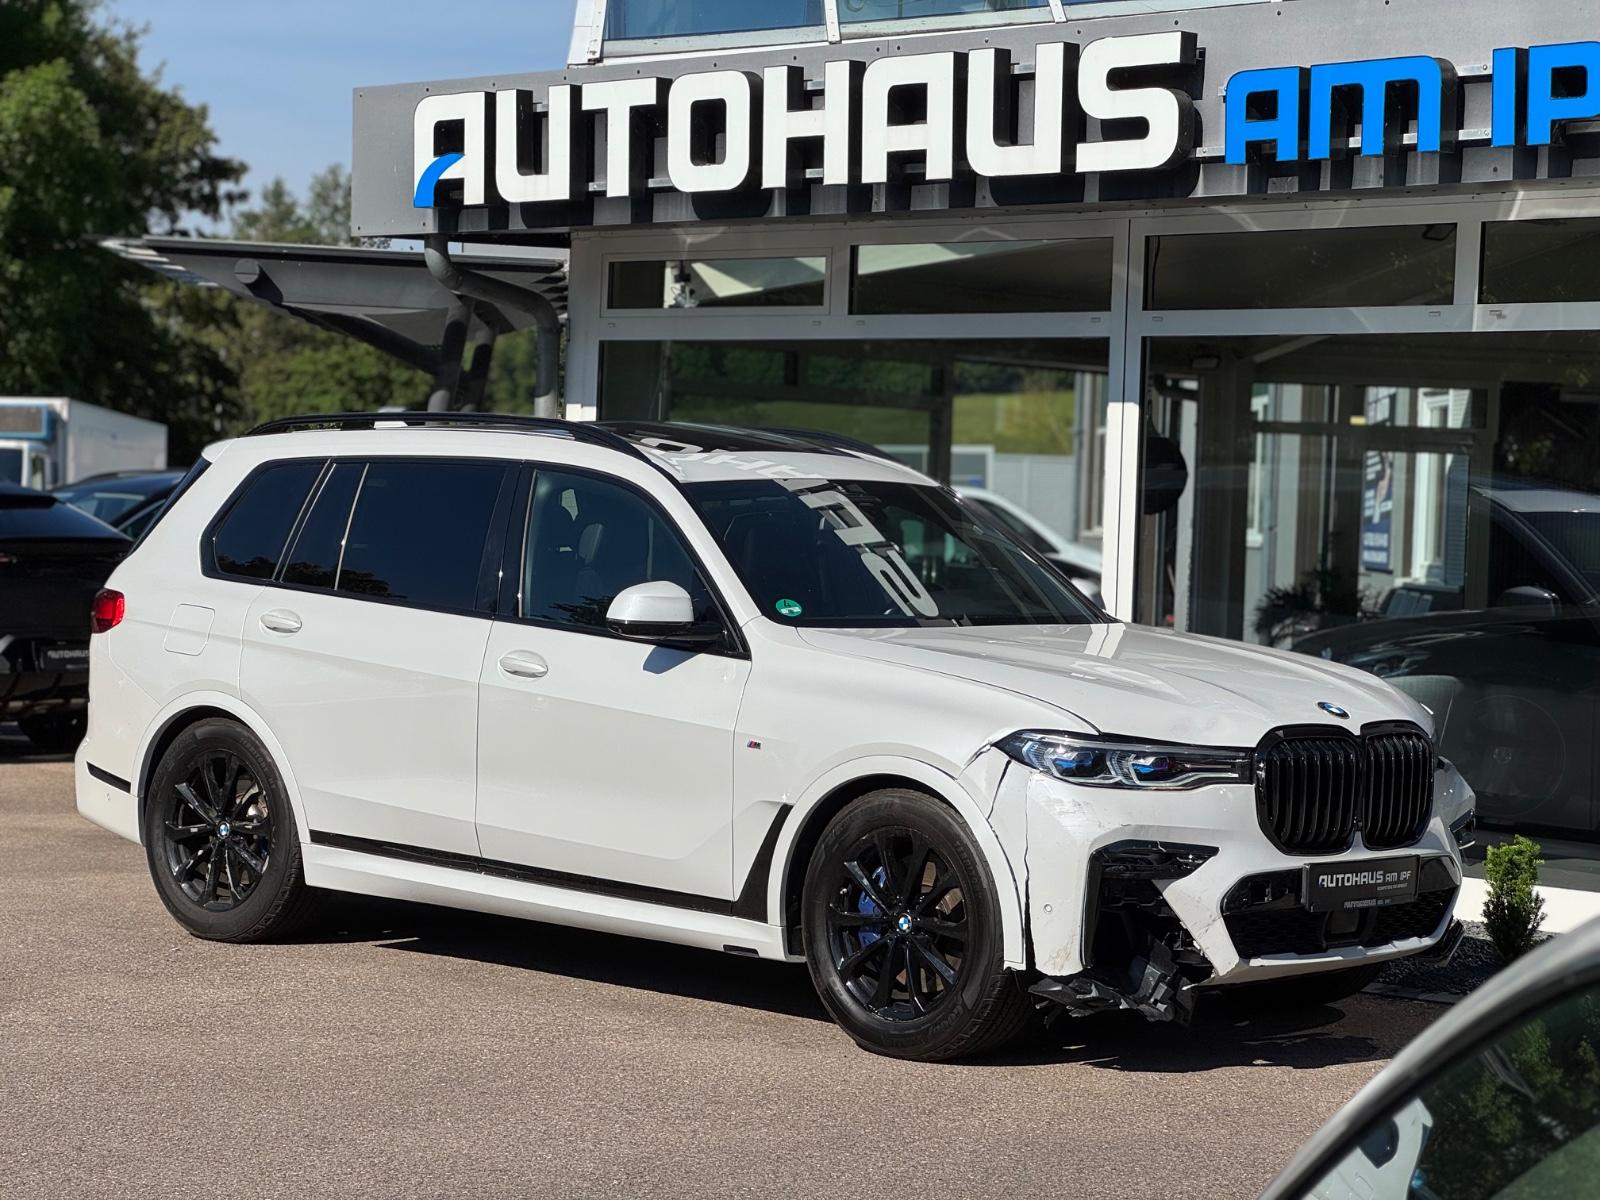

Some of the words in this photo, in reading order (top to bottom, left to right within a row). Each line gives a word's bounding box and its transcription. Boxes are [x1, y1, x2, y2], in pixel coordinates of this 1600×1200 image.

[413, 31, 1183, 208] AUTOHAUS
[1224, 55, 1441, 165] AM
[1491, 41, 1600, 148] IP
[1319, 870, 1384, 888] AUTOHAUS
[1385, 872, 1398, 882] AM
